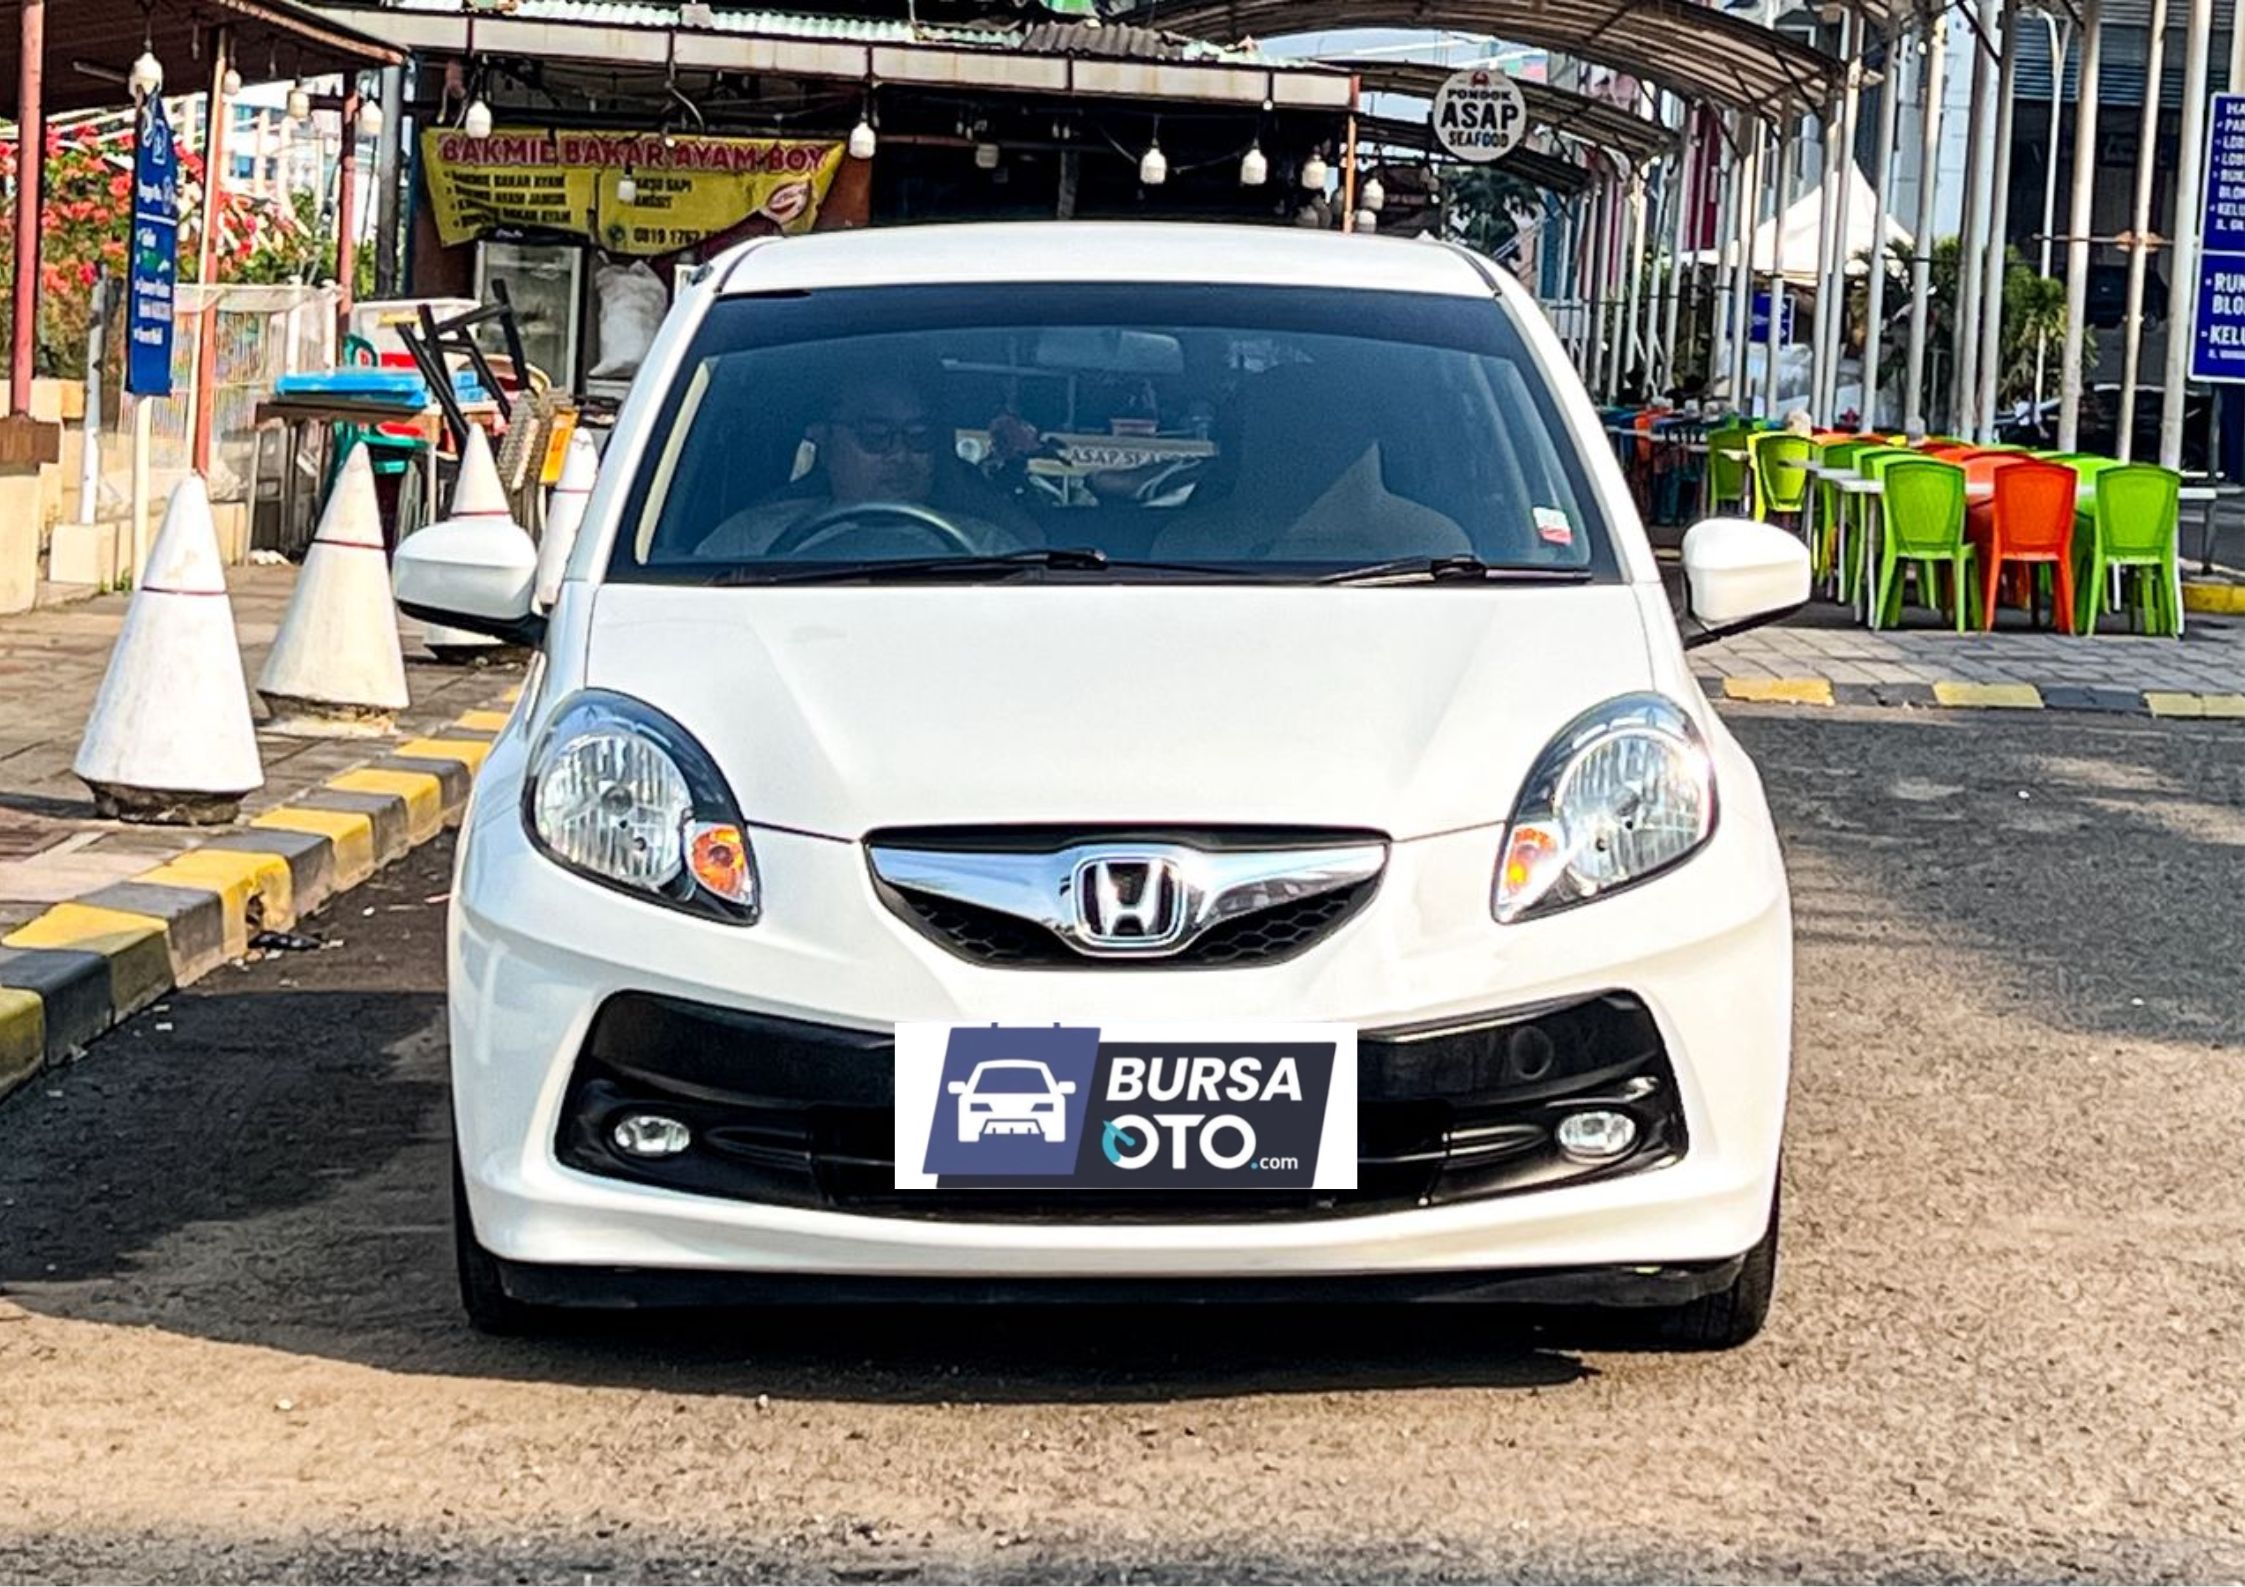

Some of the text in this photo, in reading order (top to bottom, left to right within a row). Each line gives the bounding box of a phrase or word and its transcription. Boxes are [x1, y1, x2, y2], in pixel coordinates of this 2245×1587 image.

[1447, 89, 1512, 101] PONDOK
[1440, 101, 1519, 130] ASAP
[1448, 130, 1509, 148] SEAFOOD
[443, 137, 826, 170] BAKMIE BAKAR AYAM BOY
[2212, 294, 2245, 316] BLO
